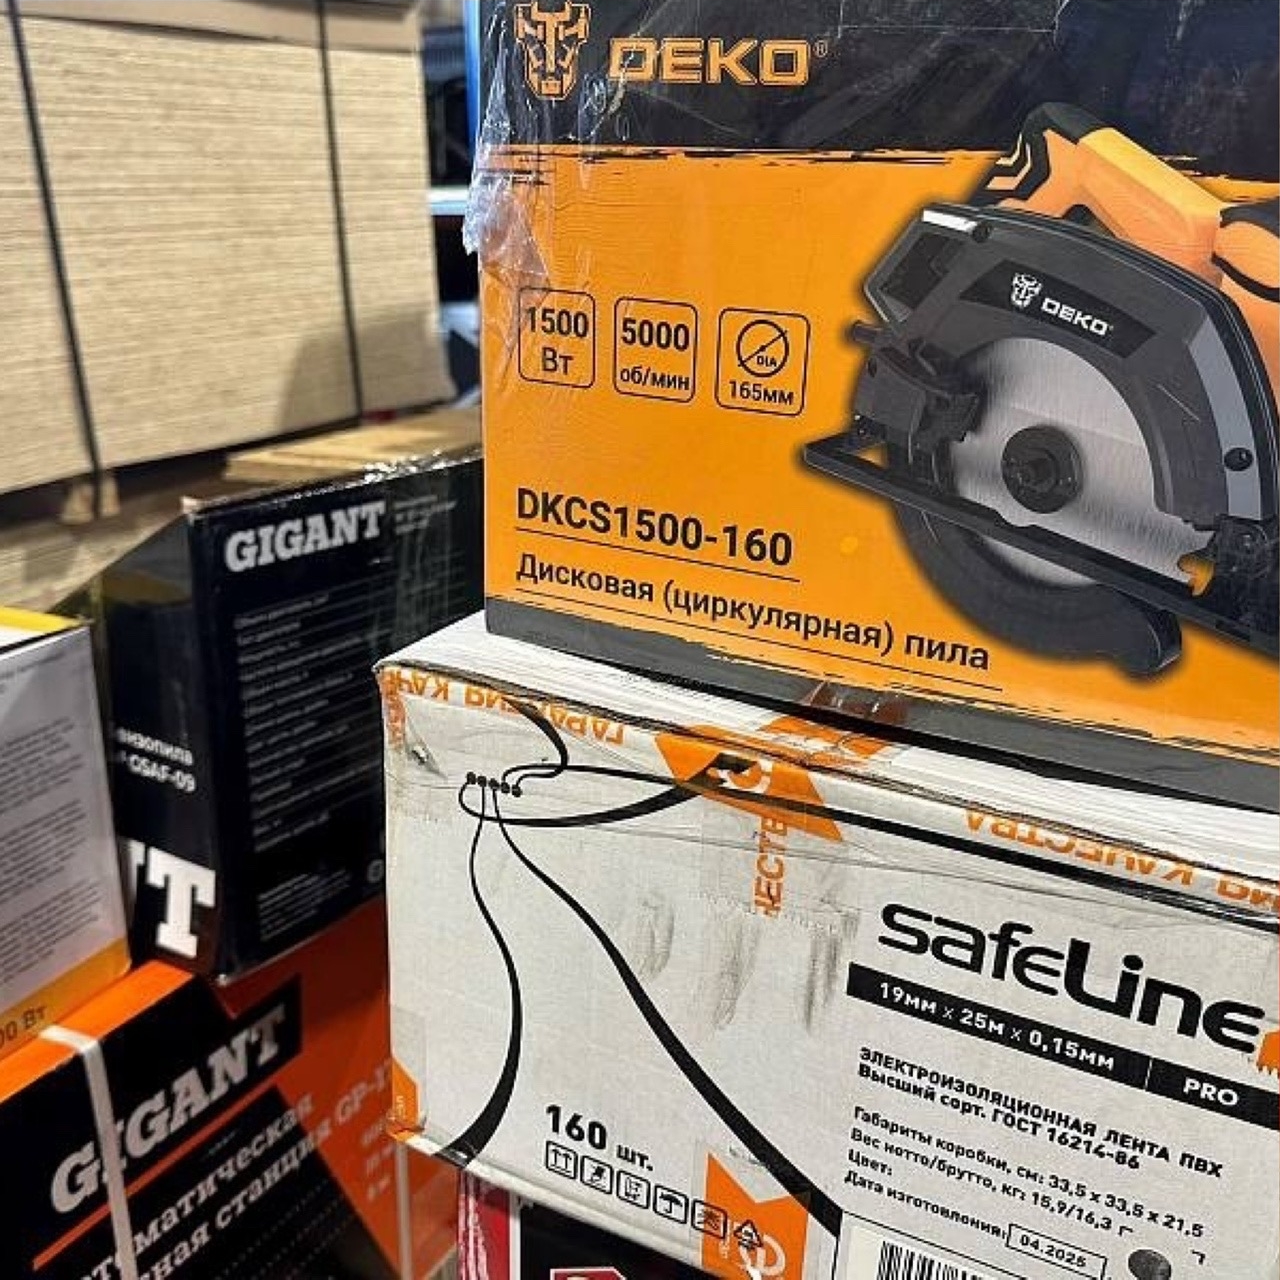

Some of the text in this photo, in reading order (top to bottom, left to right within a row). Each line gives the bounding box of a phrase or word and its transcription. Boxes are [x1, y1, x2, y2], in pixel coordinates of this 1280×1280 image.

[526, 306, 588, 338] 1500
[621, 318, 690, 352] 5000
[1041, 297, 1109, 336] DEKO
[541, 347, 574, 374] Вт
[619, 365, 691, 390] об/мин
[756, 354, 777, 368] DIA
[729, 379, 794, 406] 165мм
[225, 501, 387, 572] GIGANT
[517, 487, 793, 566] DKCS1500-160
[516, 553, 990, 670] Дисковая (циркулярная) пила
[880, 982, 936, 1014] 19мм
[961, 1009, 1003, 1036] 25м
[1183, 1078, 1239, 1106] PRO
[854, 1106, 932, 1145] Габариты
[859, 1064, 1140, 1169] Высший сорт. ГОСТ 16214-86
[860, 1047, 1223, 1178] ЭЛЕКТРОИЗОЛЯЦИОННАЯ ЛЕНТА ПВХ
[546, 1104, 653, 1172] 160 шт.
[851, 1128, 881, 1149] Вес
[848, 1148, 892, 1176] Цвет:
[844, 1170, 884, 1193] Дата
[1019, 1234, 1087, 1268] 04.2025
